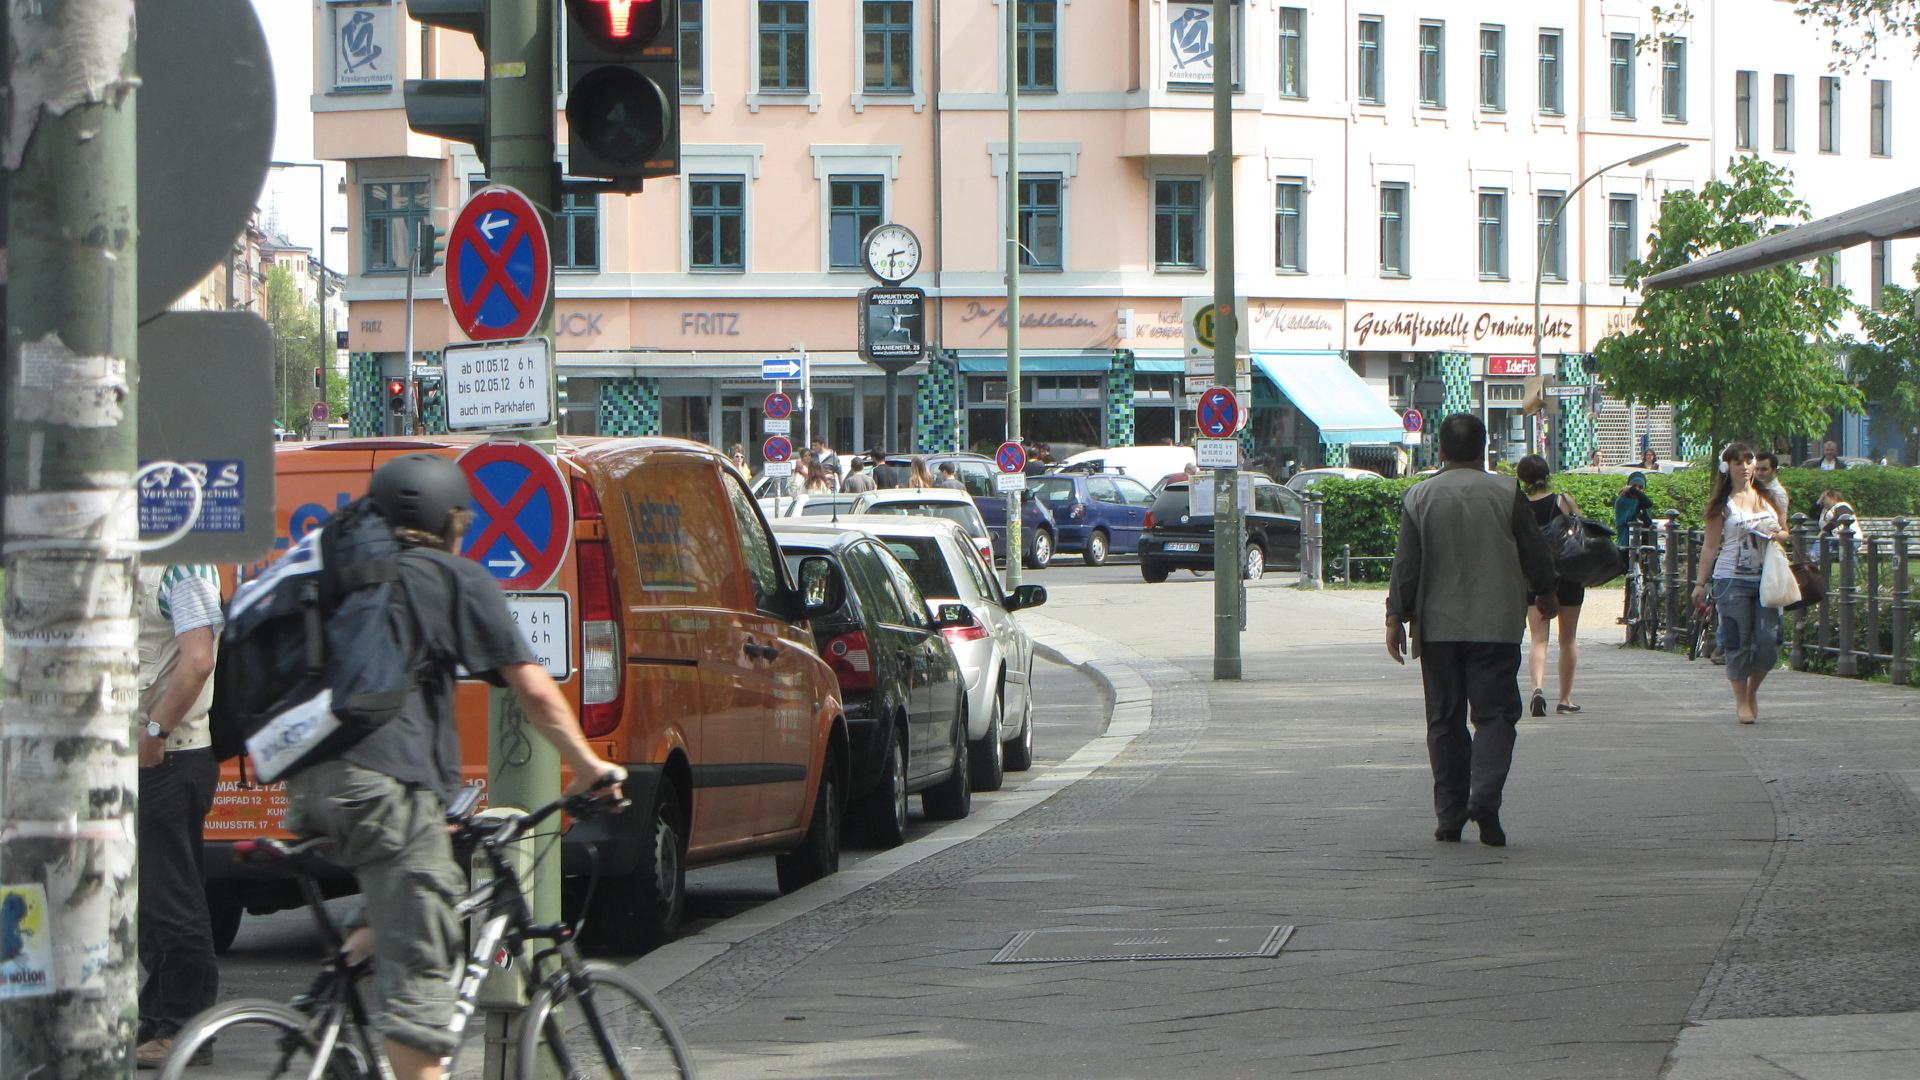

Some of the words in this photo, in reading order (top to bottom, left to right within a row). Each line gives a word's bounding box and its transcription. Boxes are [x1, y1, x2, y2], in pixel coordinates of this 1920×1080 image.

[1169, 71, 1214, 80] Krankengym
[961, 301, 995, 322] Der
[1254, 302, 1274, 322] Der
[681, 312, 741, 336] FRITZ
[1353, 311, 1469, 347] Geschäftsstelle
[1474, 312, 1574, 347] Oranienlatz
[461, 362, 472, 375] ab
[475, 358, 509, 374] 01.05.12
[518, 357, 524, 370] 6
[527, 356, 534, 369] h
[1505, 359, 1537, 374] IdeFix
[458, 381, 472, 394] bis
[474, 377, 510, 393] 02.05.12
[519, 376, 525, 389] 6
[528, 376, 535, 389] h
[460, 404, 479, 416] auch
[481, 402, 492, 415] im
[494, 400, 536, 414] Parkhafen
[142, 488, 240, 498] Verkehrsechnik
[531, 611, 538, 624] 6
[543, 611, 550, 624] h
[531, 630, 538, 643] 6
[544, 631, 551, 643] h
[252, 796, 262, 805] 12
[259, 820, 268, 829] 17
